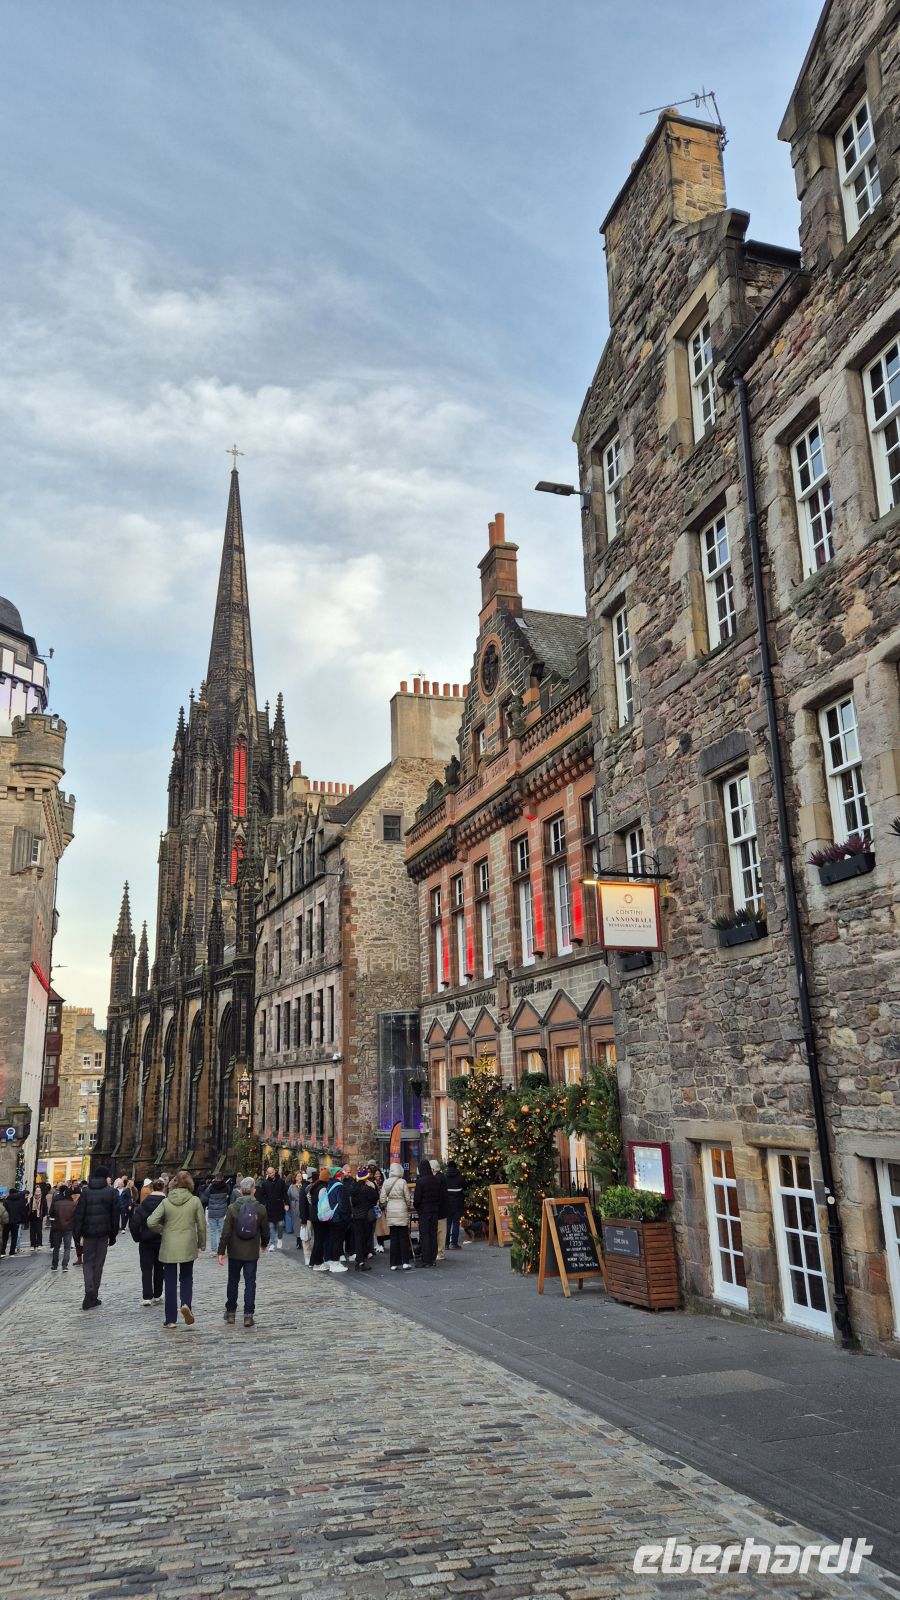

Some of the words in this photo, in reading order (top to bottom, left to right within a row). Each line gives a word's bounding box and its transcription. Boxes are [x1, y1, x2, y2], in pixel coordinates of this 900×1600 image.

[513, 978, 553, 998] Experience
[455, 996, 474, 1011] Scotch
[475, 991, 496, 1007] Whisky
